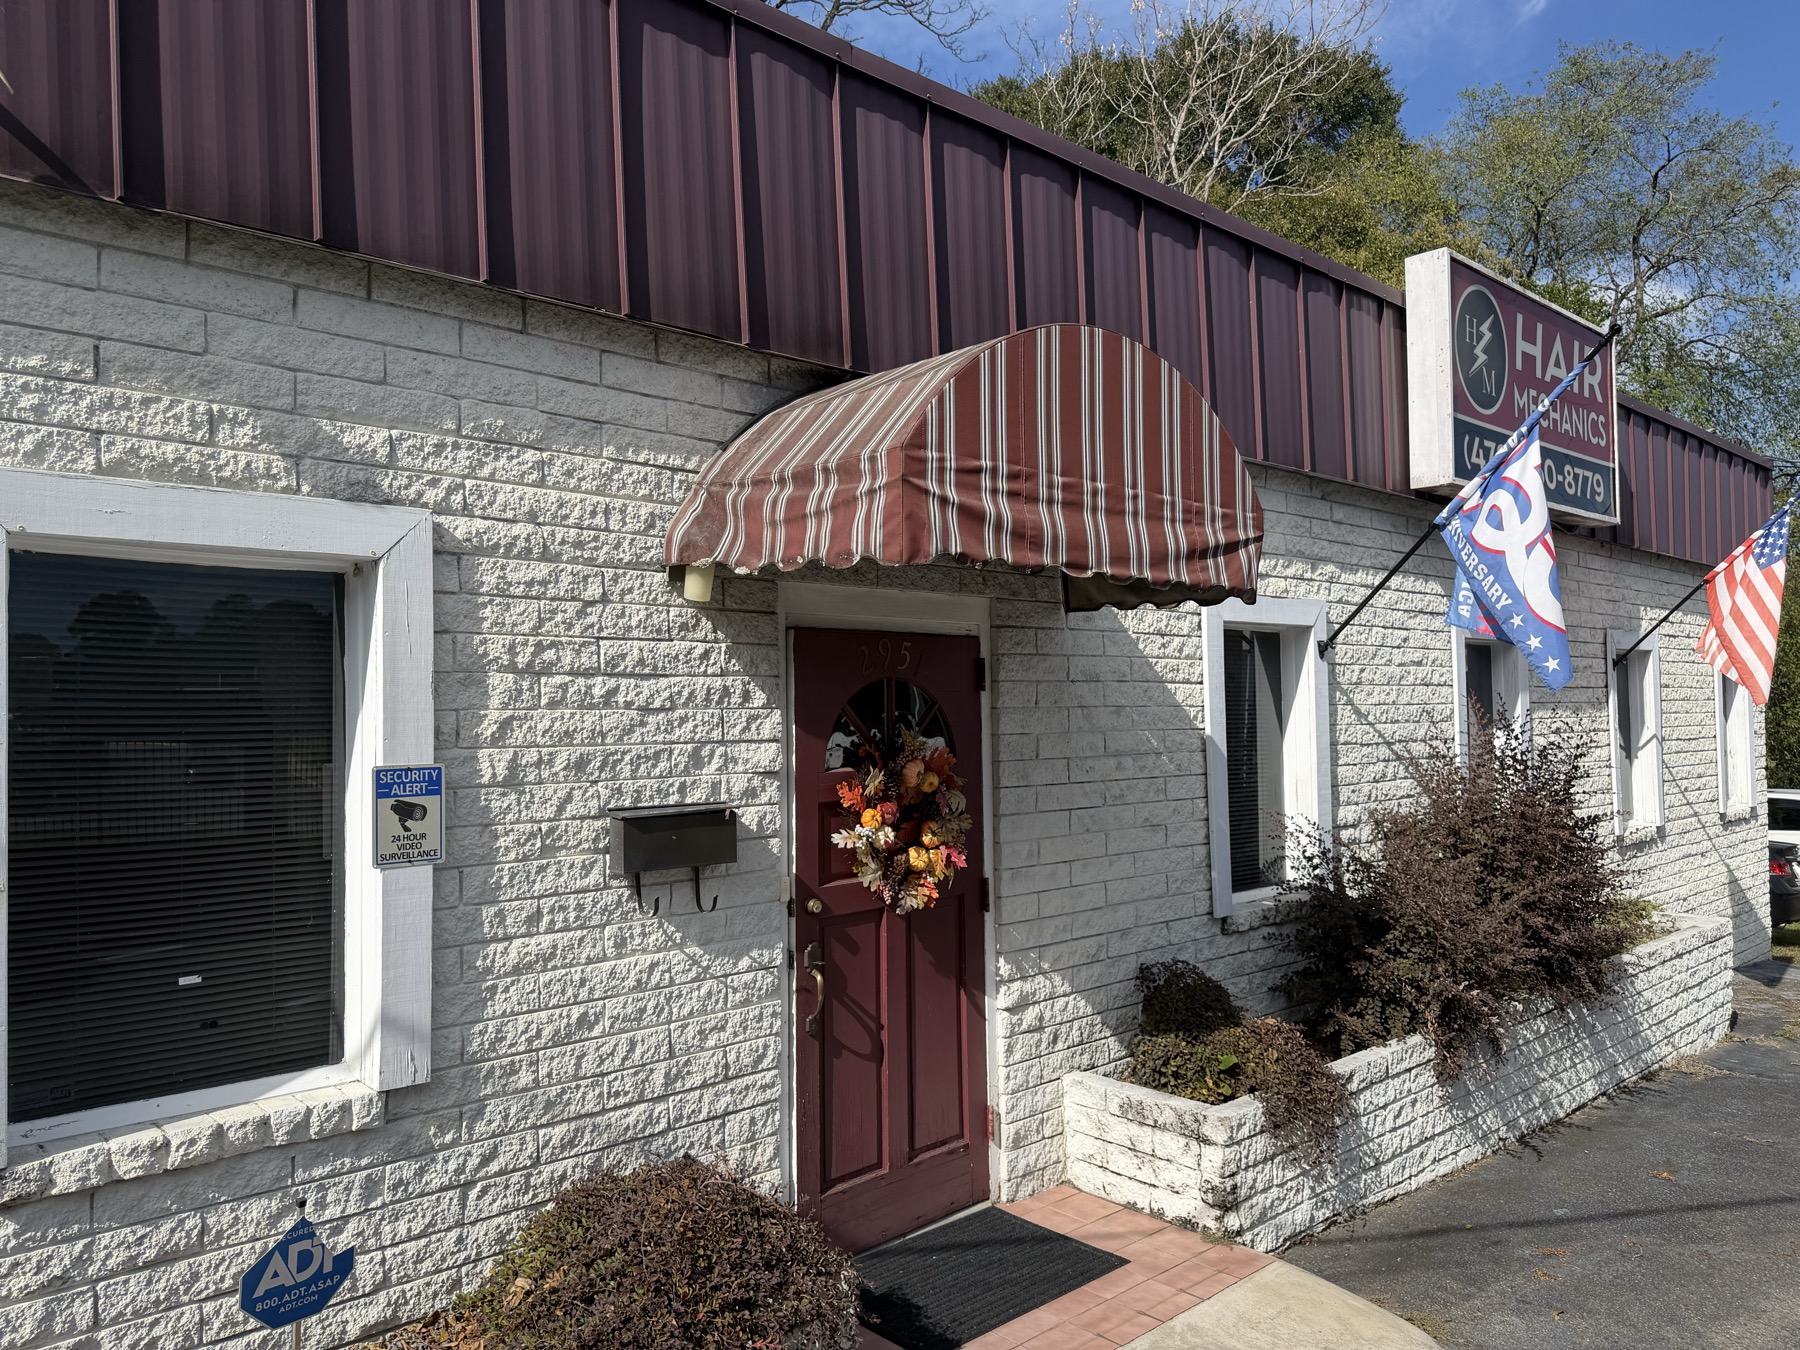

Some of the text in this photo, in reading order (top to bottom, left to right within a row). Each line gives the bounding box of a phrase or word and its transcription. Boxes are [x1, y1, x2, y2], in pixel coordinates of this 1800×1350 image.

[1464, 314, 1478, 345] H
[1515, 312, 1604, 404] HAIR
[1482, 366, 1497, 397] M
[1513, 382, 1607, 447] MECHANICS
[380, 769, 439, 784] SECURITY
[390, 782, 428, 796] ALERT
[391, 832, 427, 843] 24 HOUR
[396, 841, 422, 851] VIDEO
[379, 848, 438, 862] SURVEILLANCE
[252, 1237, 335, 1299] ADT
[255, 1274, 340, 1312] 800.ADT.ASAP
[278, 1294, 318, 1314] ADT.COM
